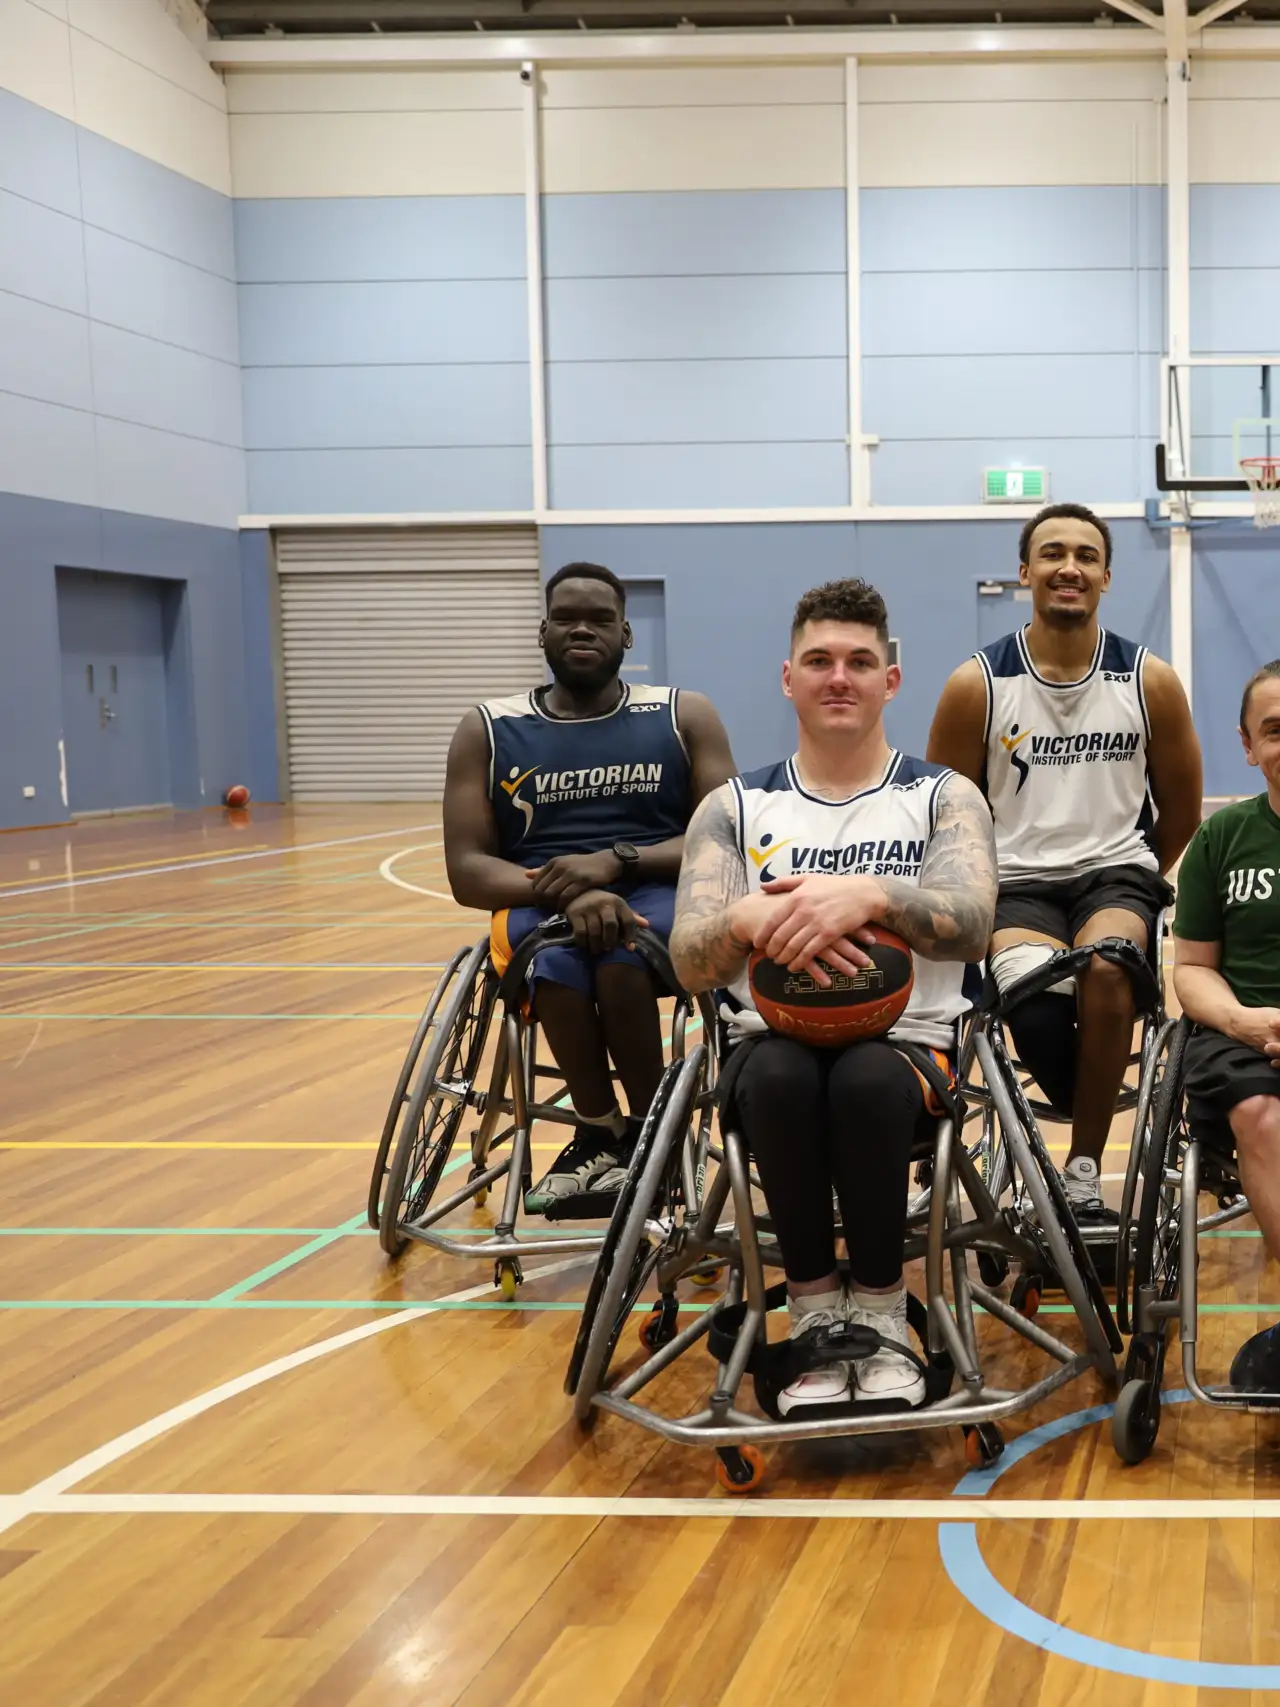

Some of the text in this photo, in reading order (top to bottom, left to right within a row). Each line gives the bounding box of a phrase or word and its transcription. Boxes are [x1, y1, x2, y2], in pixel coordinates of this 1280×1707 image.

[1103, 672, 1131, 683] 2XU
[629, 703, 661, 713] 2XU
[1031, 732, 1140, 755] VICTORIAN
[1031, 751, 1136, 766] INSTITUTE OF SPORT
[534, 763, 663, 793] VICTORIAN
[536, 782, 660, 805] INSTITUTE OF SPORT
[790, 840, 925, 872] VICTORIAN
[874, 862, 921, 877] SPORT
